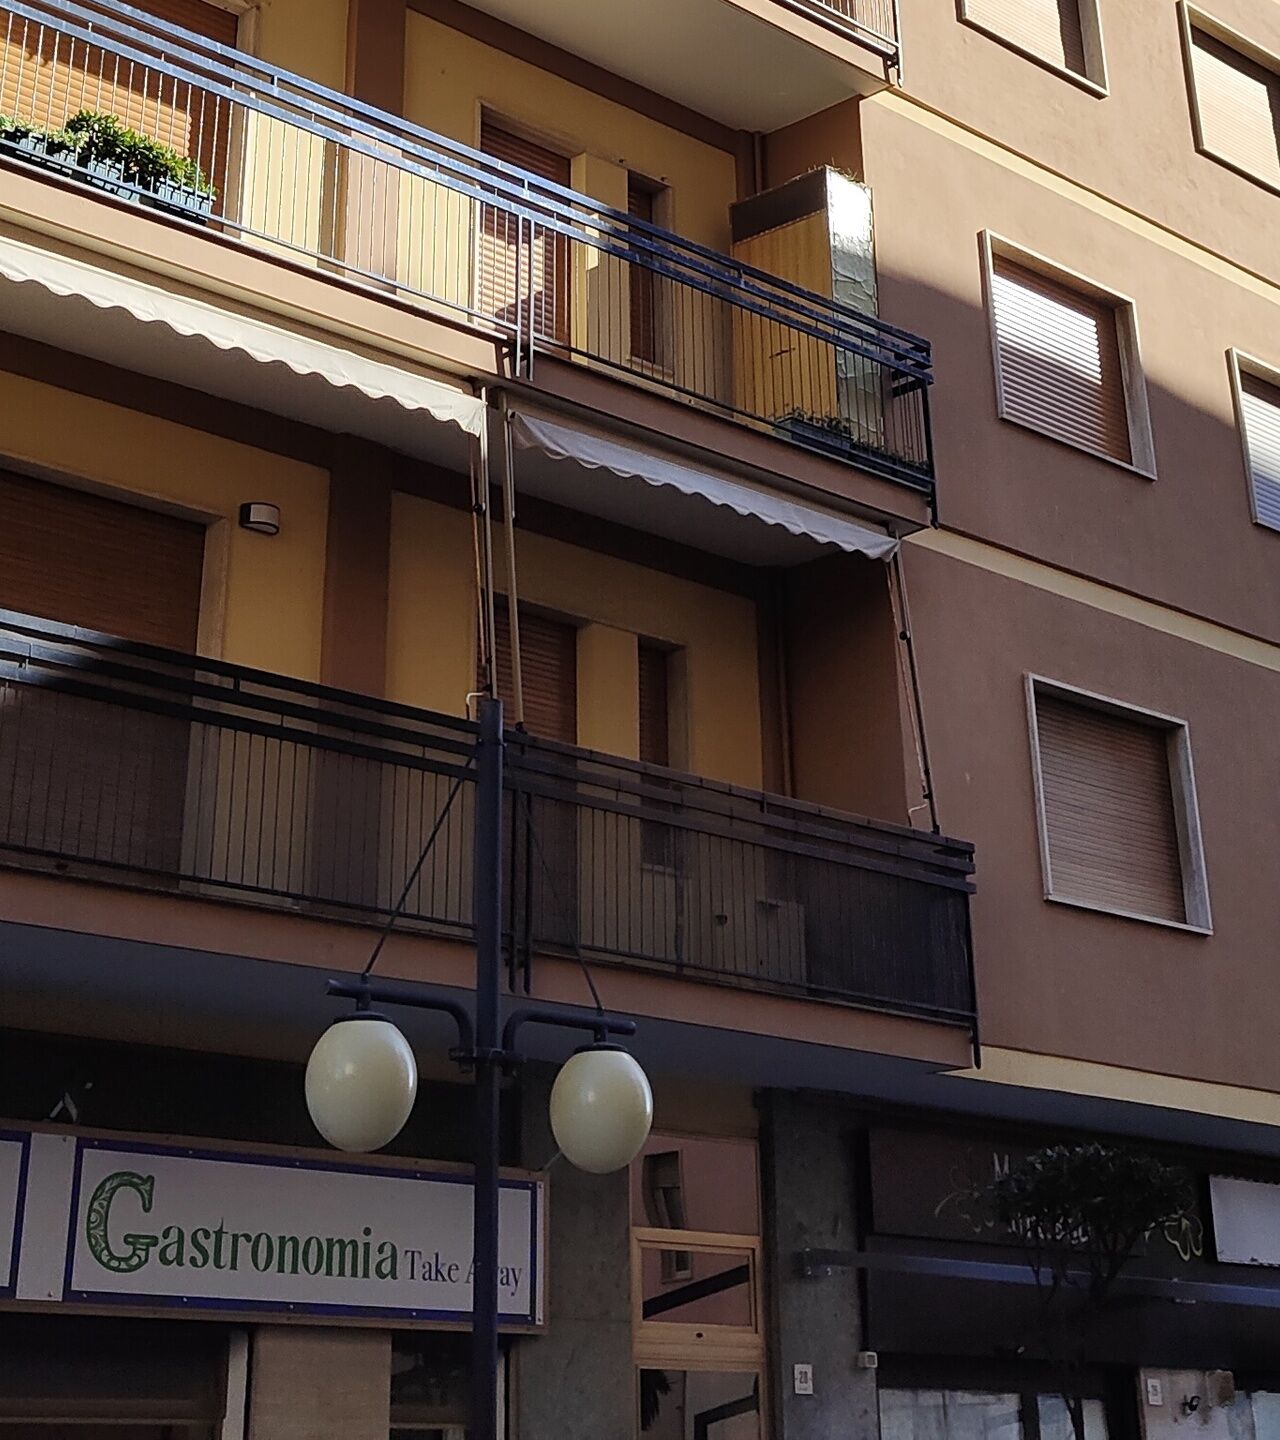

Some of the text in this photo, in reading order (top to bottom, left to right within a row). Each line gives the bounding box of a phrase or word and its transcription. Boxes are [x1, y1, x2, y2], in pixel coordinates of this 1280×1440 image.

[86, 1171, 523, 1298] Gastronomia Take ay
